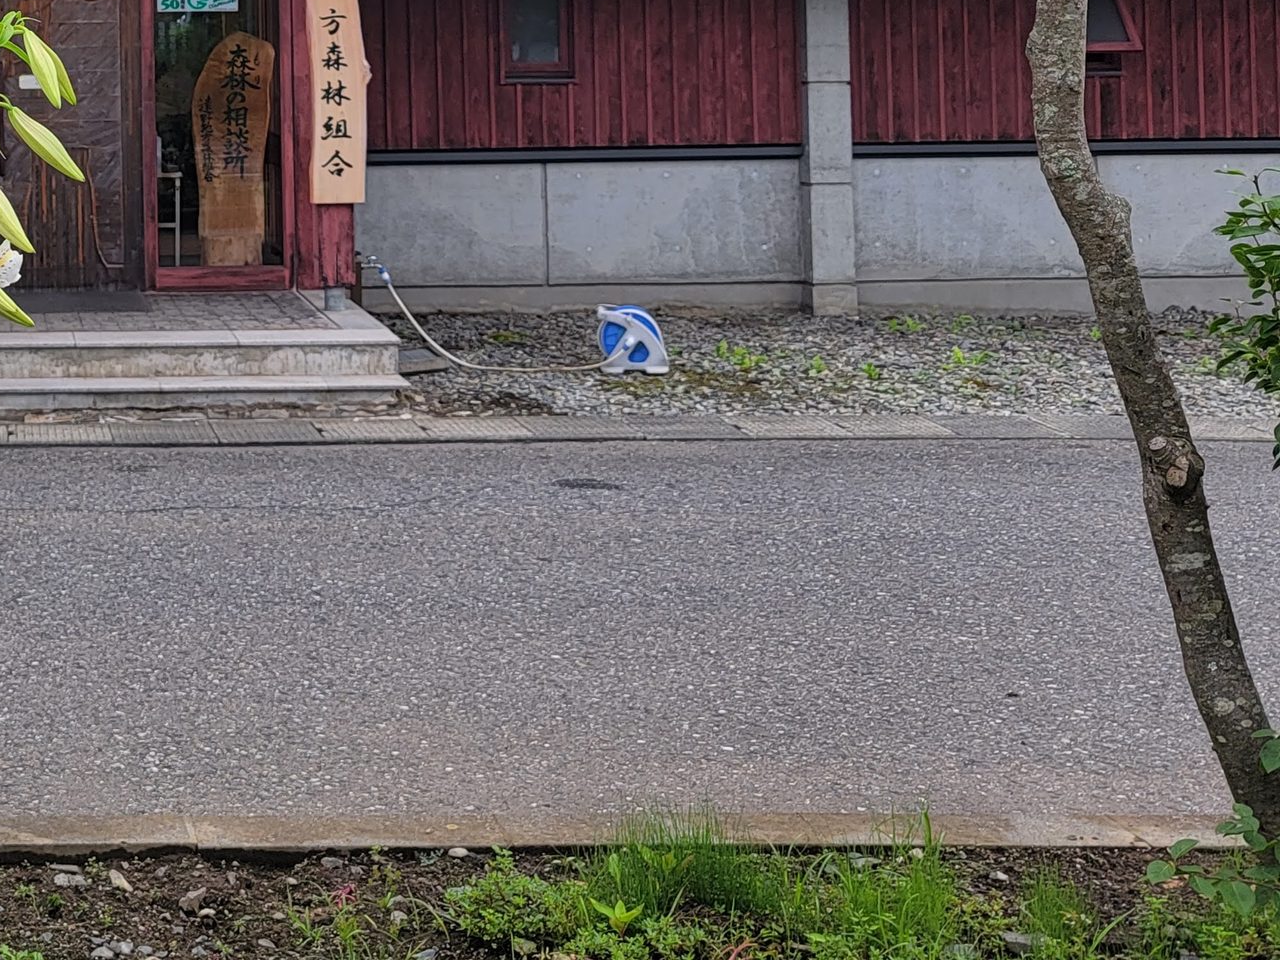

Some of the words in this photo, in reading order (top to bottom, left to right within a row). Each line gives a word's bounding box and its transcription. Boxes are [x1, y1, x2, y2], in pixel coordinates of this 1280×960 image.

[161, 0, 180, 10] 50
[221, 44, 261, 179] 森林の相談所
